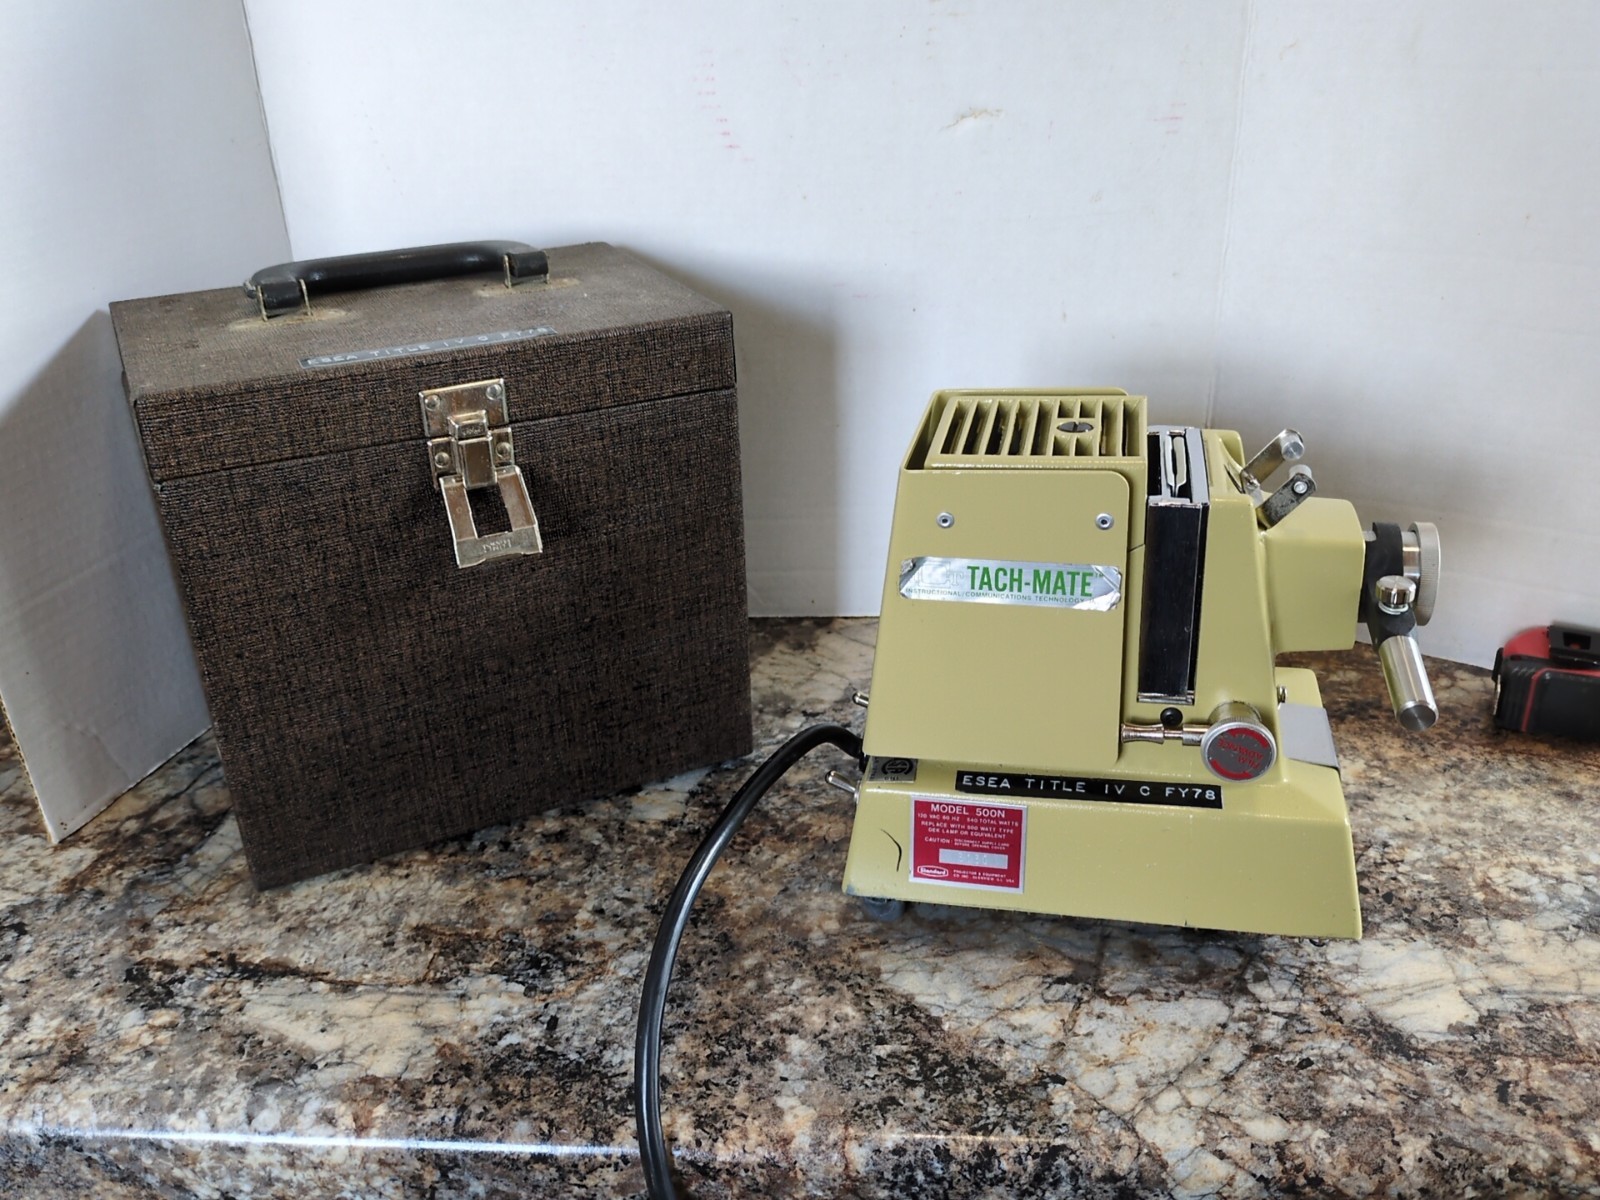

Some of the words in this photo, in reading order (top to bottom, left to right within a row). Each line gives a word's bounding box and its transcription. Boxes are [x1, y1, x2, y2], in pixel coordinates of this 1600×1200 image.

[967, 565, 1093, 597] TACH-MATE
[961, 774, 1011, 790] ESEA
[1025, 778, 1086, 793] TITLE
[1104, 783, 1126, 795] IV
[1139, 785, 1151, 797] C
[1165, 786, 1217, 801] FY78
[931, 803, 969, 815] MODEL
[975, 808, 1006, 818] 500N
[970, 830, 1006, 839] EQUIVALENT
